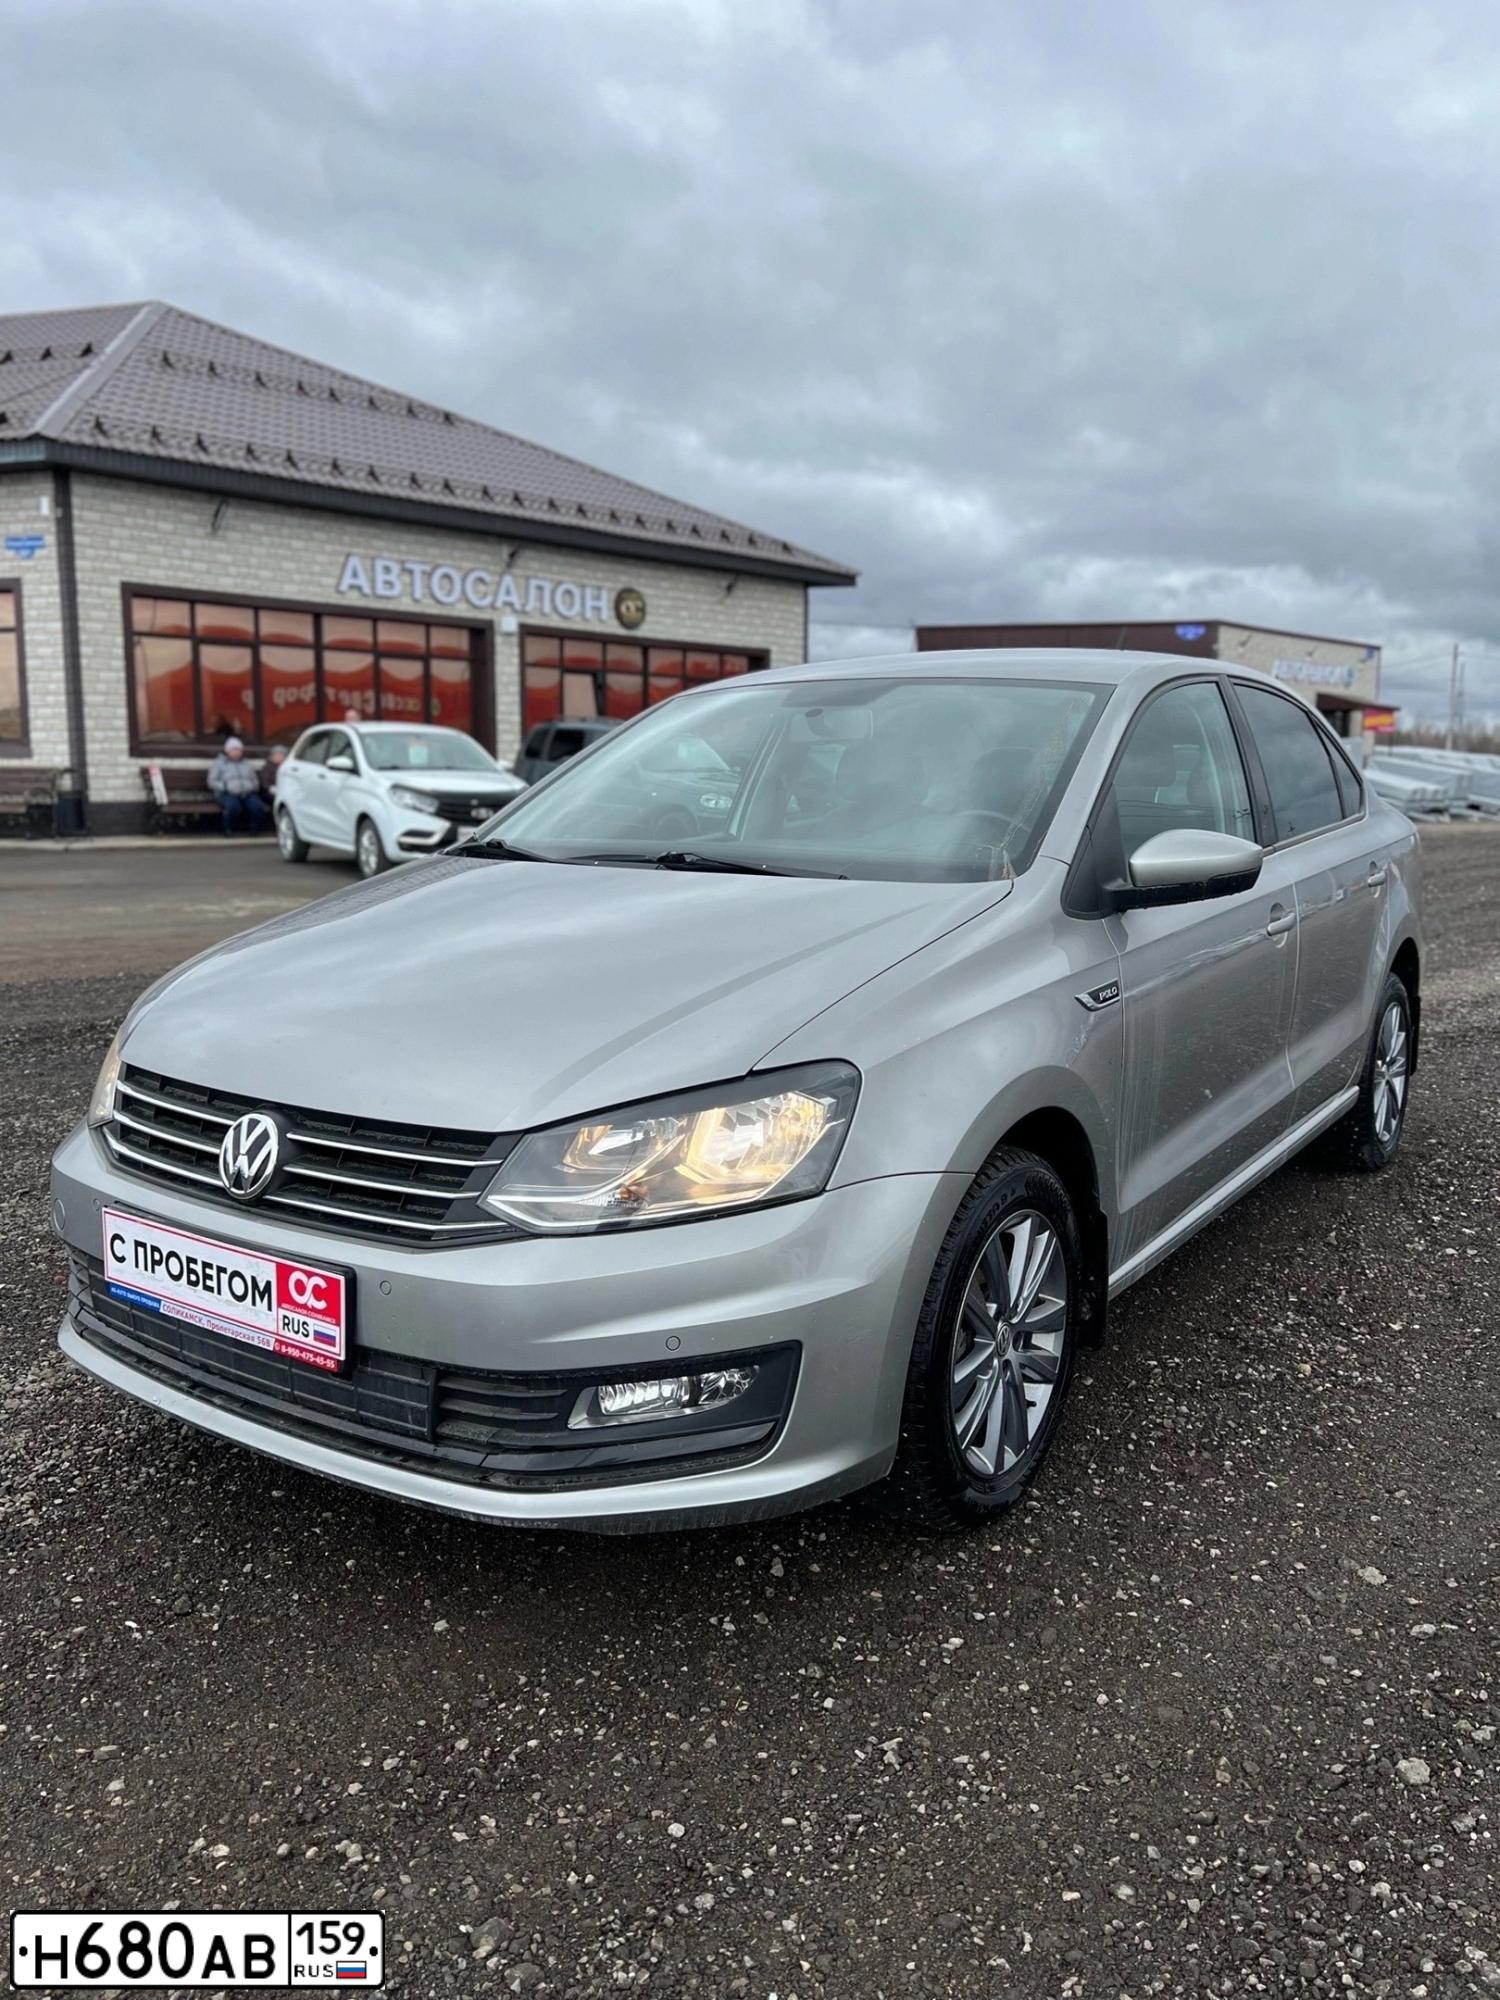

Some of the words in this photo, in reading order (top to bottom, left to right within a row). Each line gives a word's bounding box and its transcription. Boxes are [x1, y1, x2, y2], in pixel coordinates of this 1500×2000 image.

[339, 553, 610, 622] АВТОСАЛОН
[1099, 986, 1118, 1001] POLO
[110, 1233, 126, 1263] С
[133, 1239, 272, 1312] ПРОБЕГОМ
[282, 1314, 310, 1338] RUS
